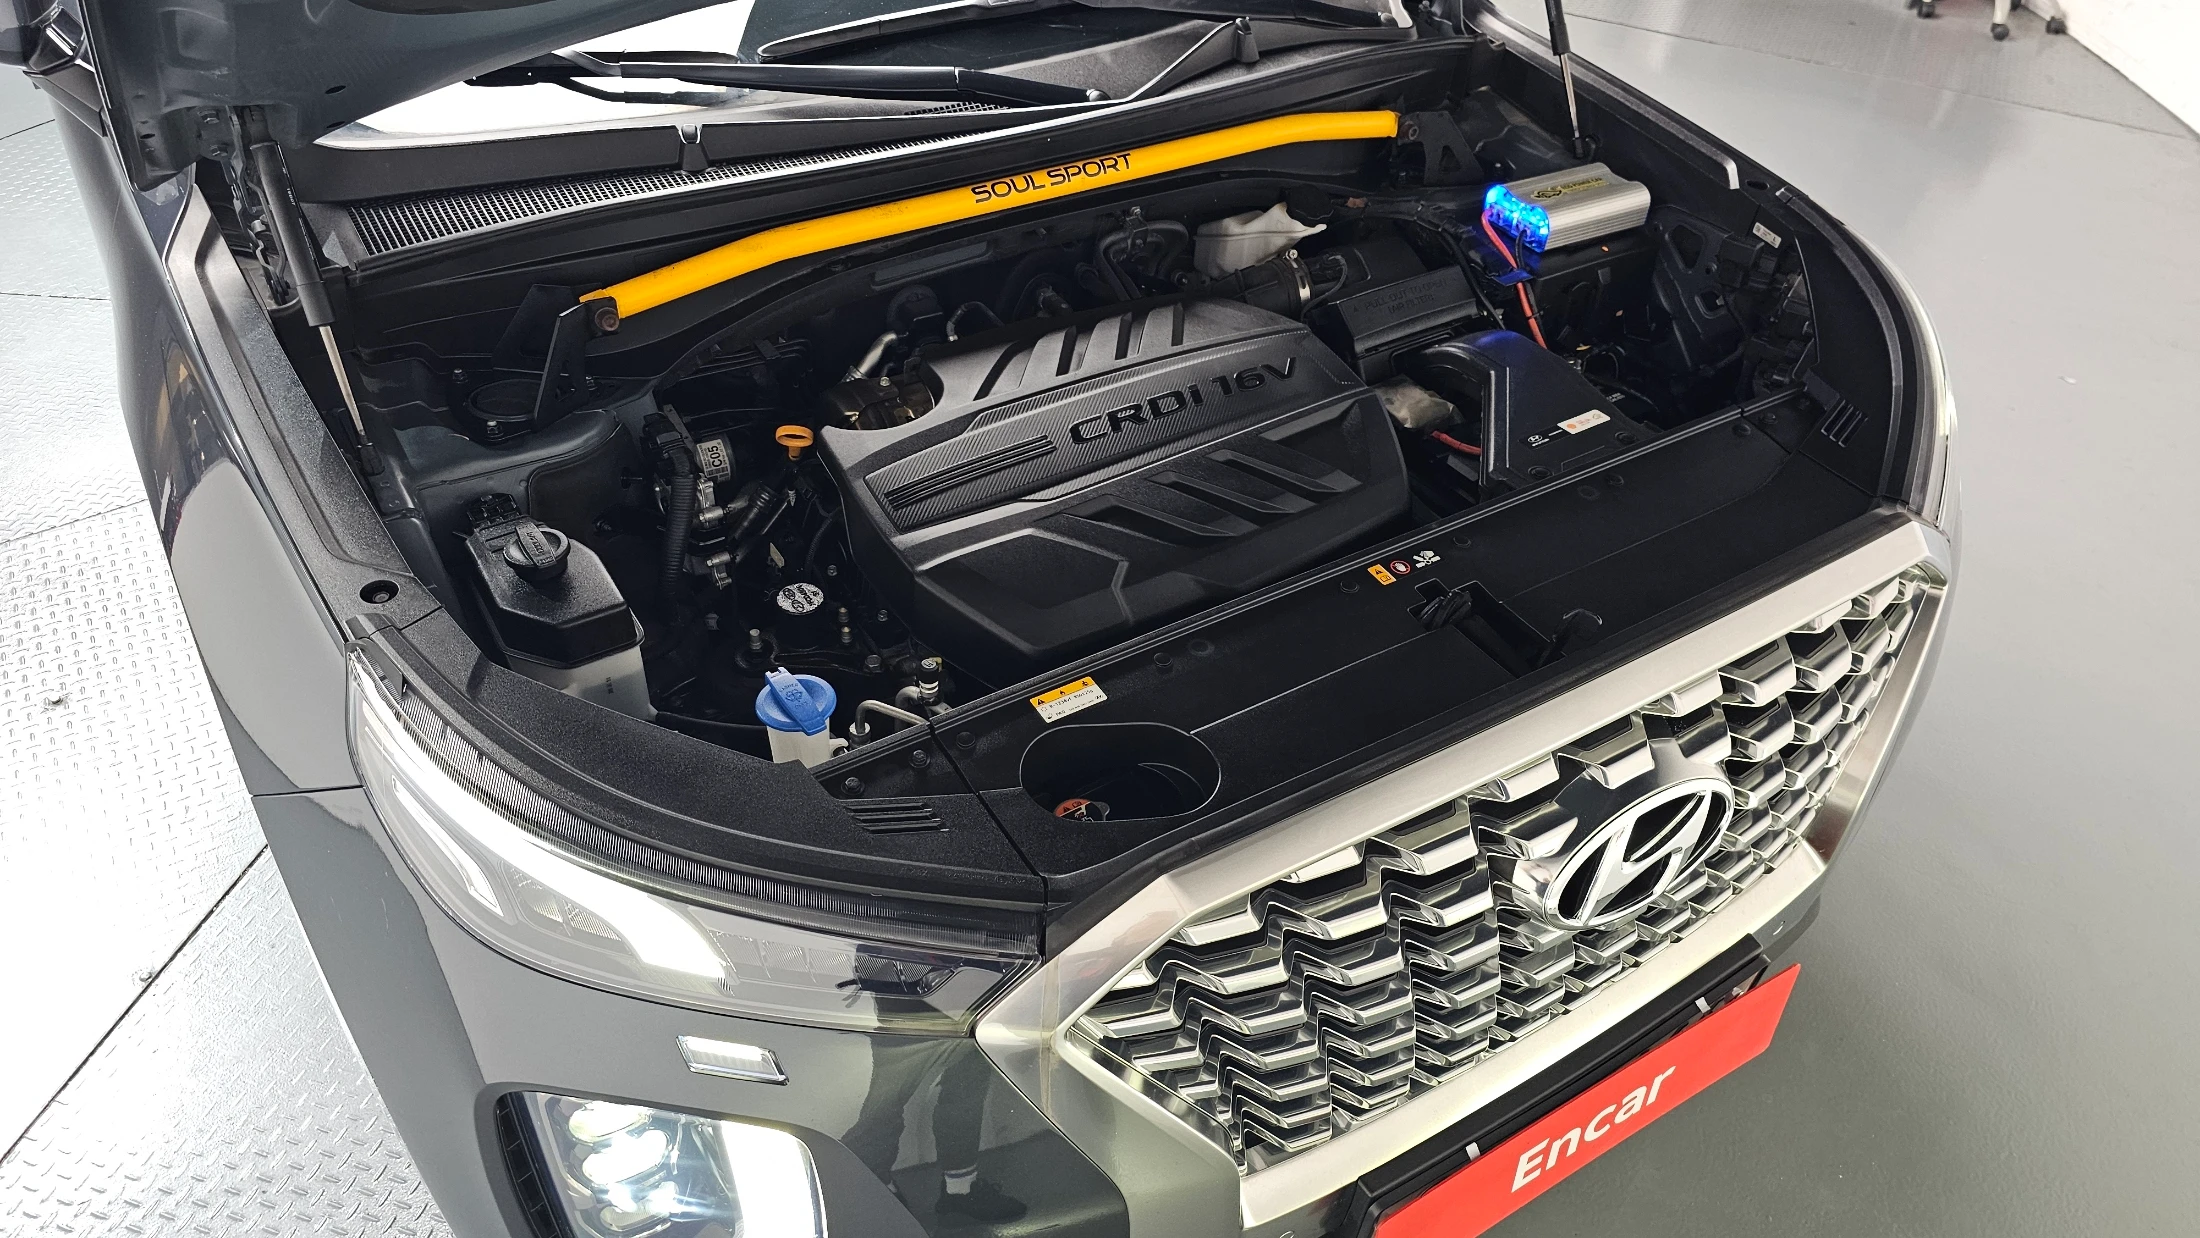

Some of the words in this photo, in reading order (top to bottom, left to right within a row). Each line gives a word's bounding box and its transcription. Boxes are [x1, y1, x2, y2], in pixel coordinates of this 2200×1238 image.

[970, 175, 1046, 204] SOUL
[1046, 153, 1132, 186] SPORT
[1365, 295, 1388, 310] PULL
[1388, 288, 1408, 301] OUT
[1410, 285, 1423, 295] TO
[1209, 357, 1297, 397] 16V
[1511, 1065, 1676, 1193] Encar
